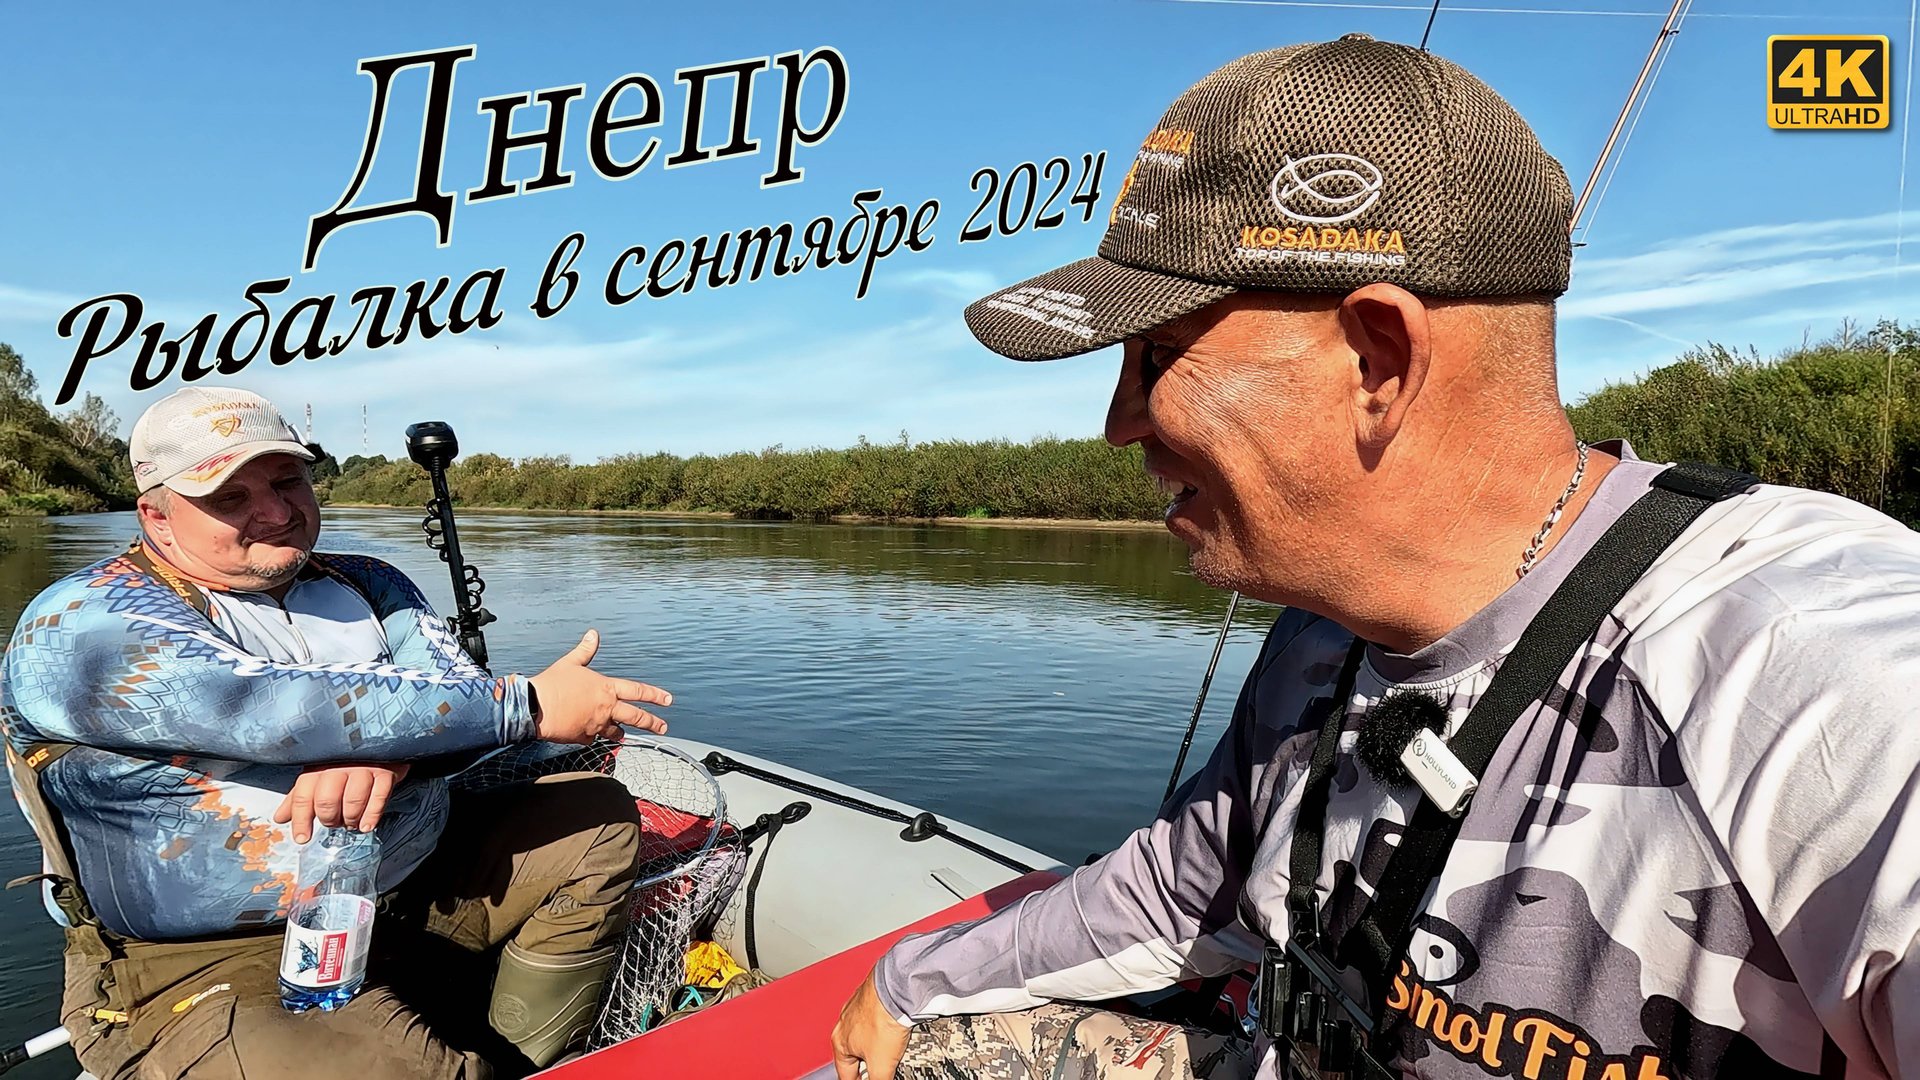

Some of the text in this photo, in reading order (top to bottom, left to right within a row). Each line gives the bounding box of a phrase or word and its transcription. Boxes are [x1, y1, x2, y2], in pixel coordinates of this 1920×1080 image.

[1242, 225, 1405, 253] KOSADAKA
[1296, 251, 1331, 263] THE
[1334, 252, 1406, 266] FISHING
[1424, 752, 1457, 790] HOLLYLAND
